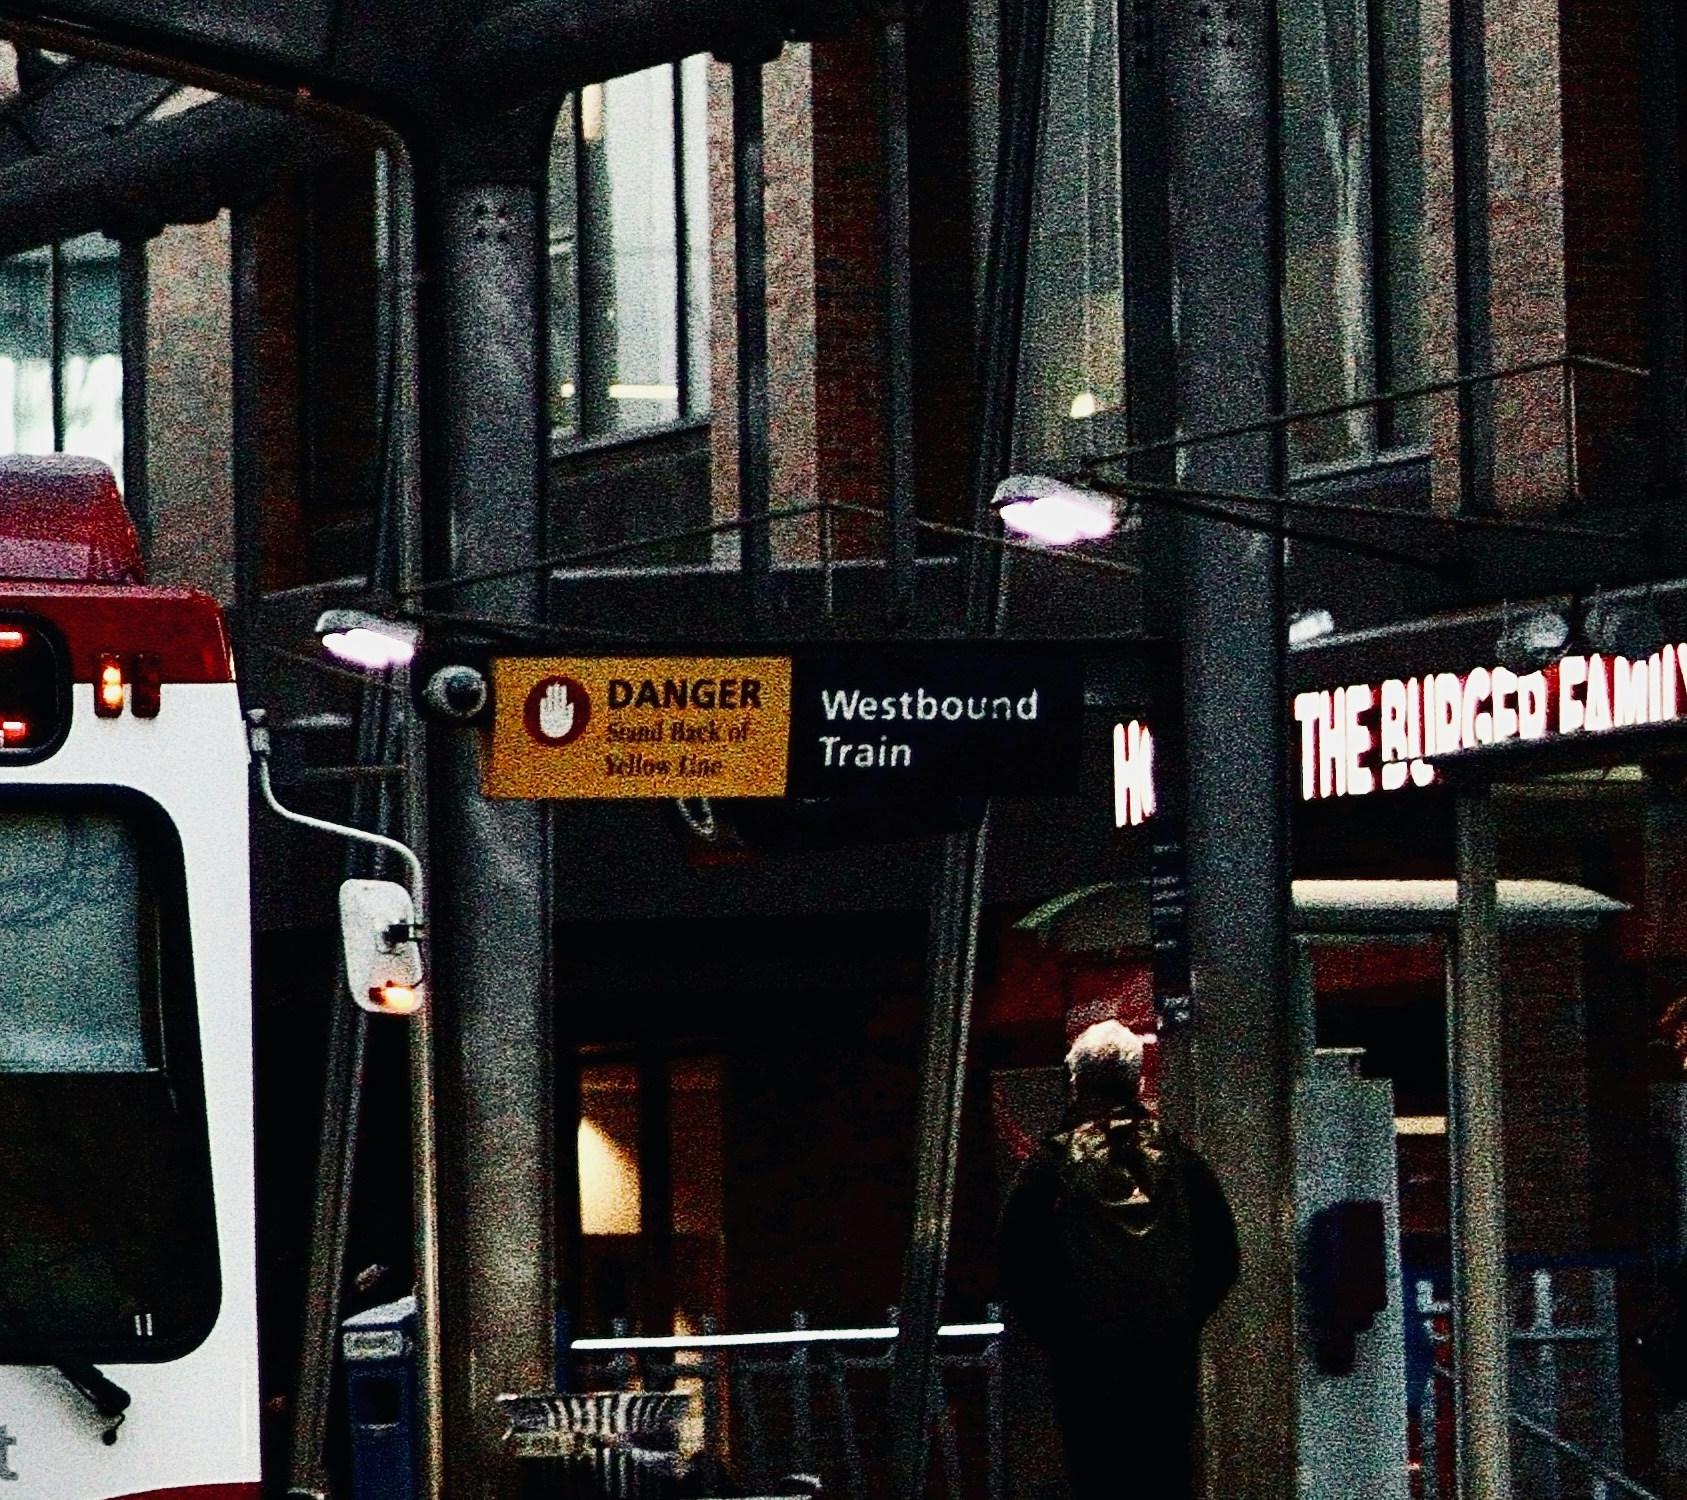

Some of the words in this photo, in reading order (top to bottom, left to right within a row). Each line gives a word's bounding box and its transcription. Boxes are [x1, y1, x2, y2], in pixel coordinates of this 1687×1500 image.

[608, 678, 762, 710] DANGER
[821, 687, 1039, 722] Westbound
[606, 720, 663, 743] Stand
[671, 720, 721, 743] Back
[728, 719, 751, 743] of
[1294, 683, 1374, 801] THE
[606, 753, 672, 778] Yellow
[678, 754, 724, 777] Line
[819, 735, 913, 769] Train
